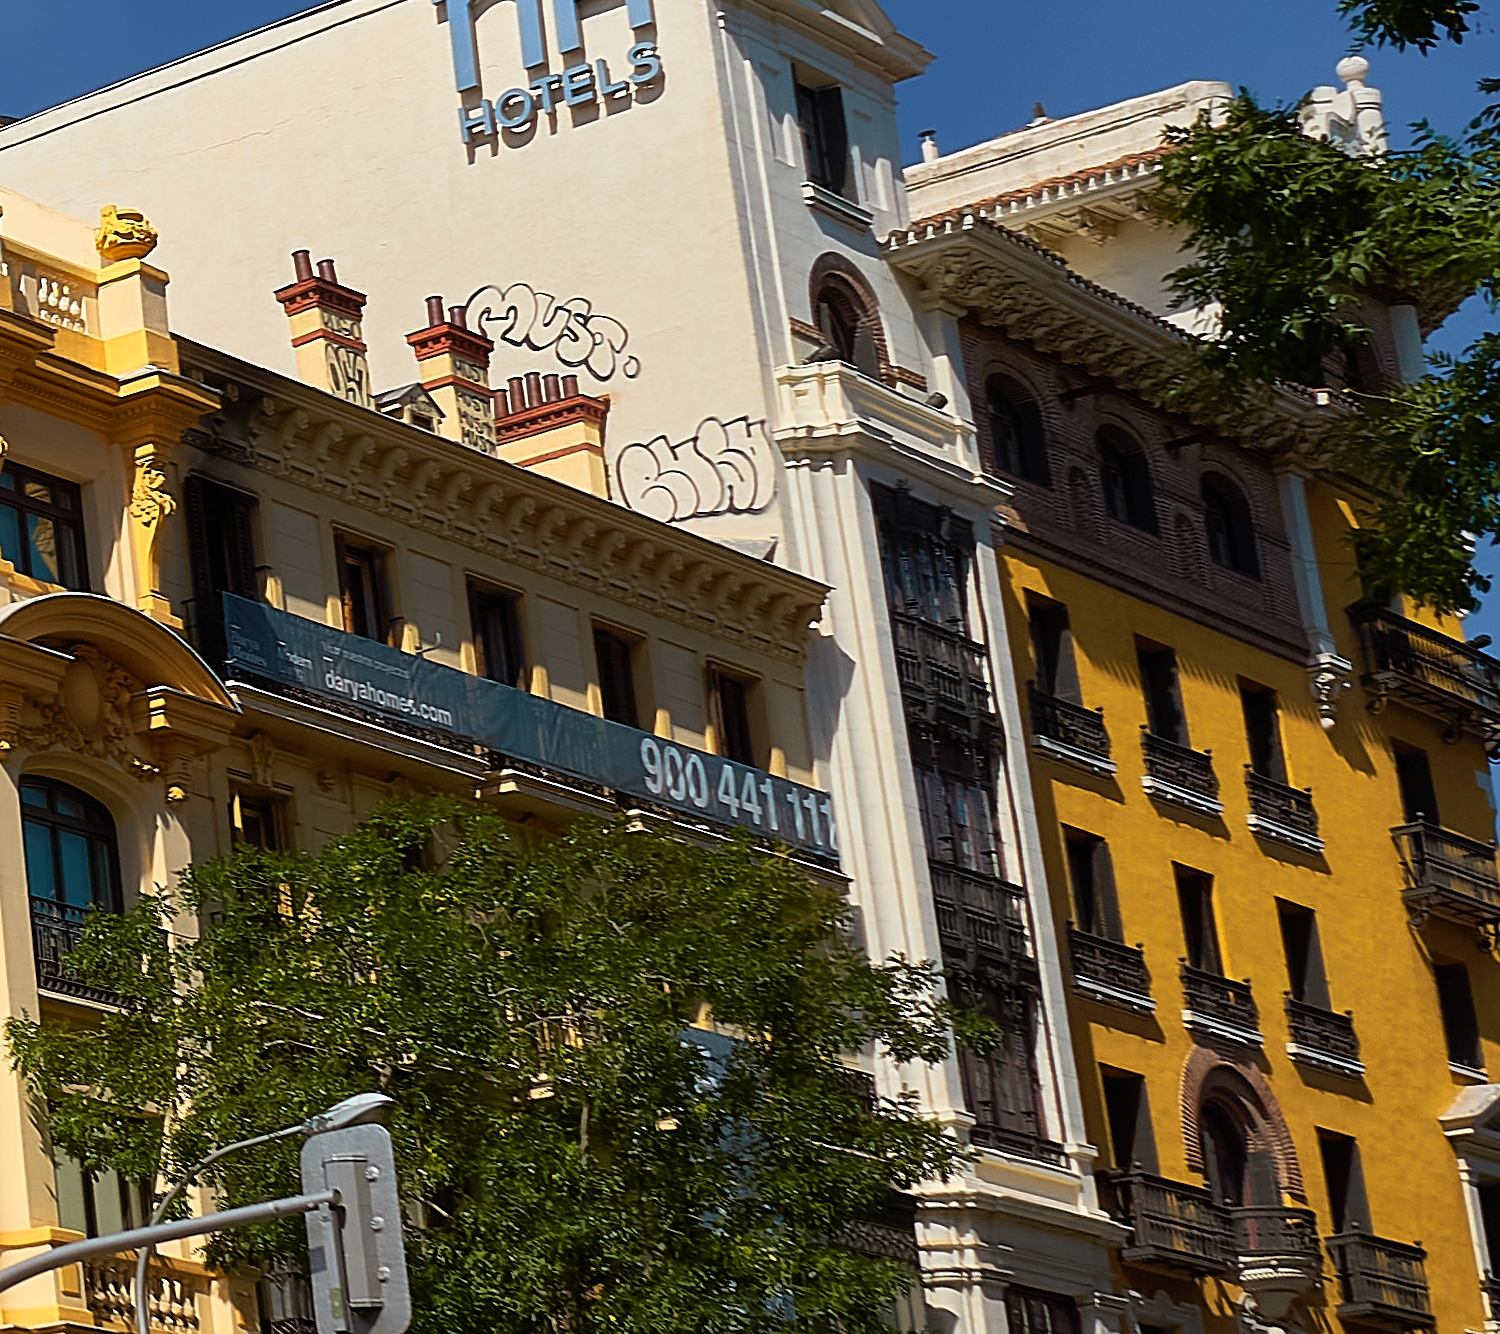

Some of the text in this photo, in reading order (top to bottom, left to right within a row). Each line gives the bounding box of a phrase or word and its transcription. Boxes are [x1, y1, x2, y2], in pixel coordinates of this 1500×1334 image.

[458, 42, 660, 144] HOTELS
[324, 669, 453, 727] daryahomes.com
[640, 738, 709, 809] 900
[718, 764, 778, 831] 441
